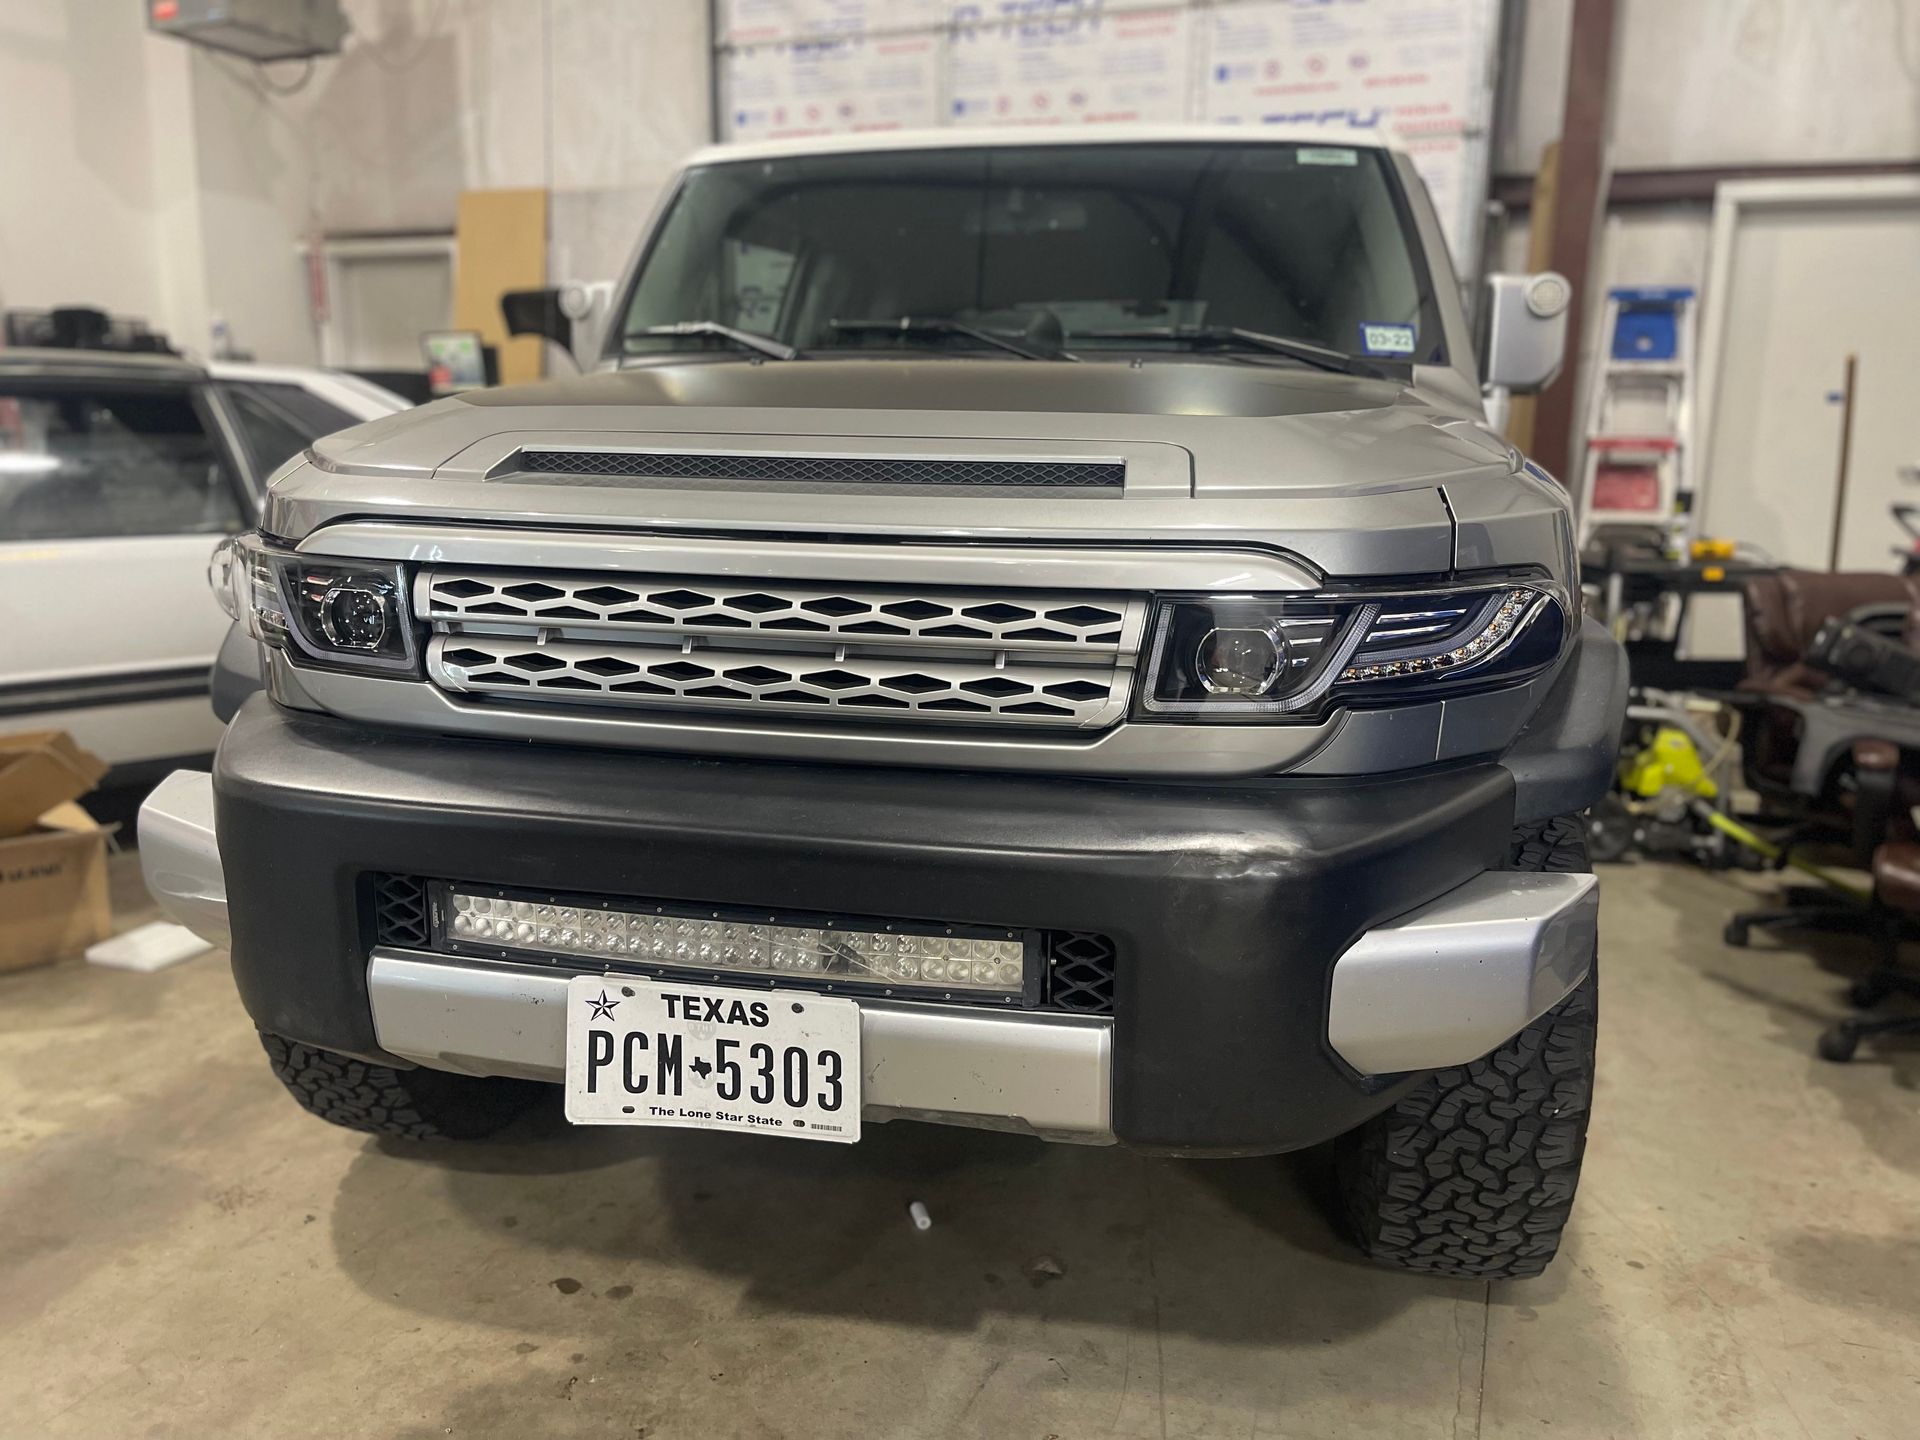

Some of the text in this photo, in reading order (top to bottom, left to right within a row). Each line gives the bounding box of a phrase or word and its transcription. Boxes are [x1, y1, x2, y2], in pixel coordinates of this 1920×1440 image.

[660, 993, 770, 1028] TEXAS
[649, 1106, 783, 1127] The Lone Star State
